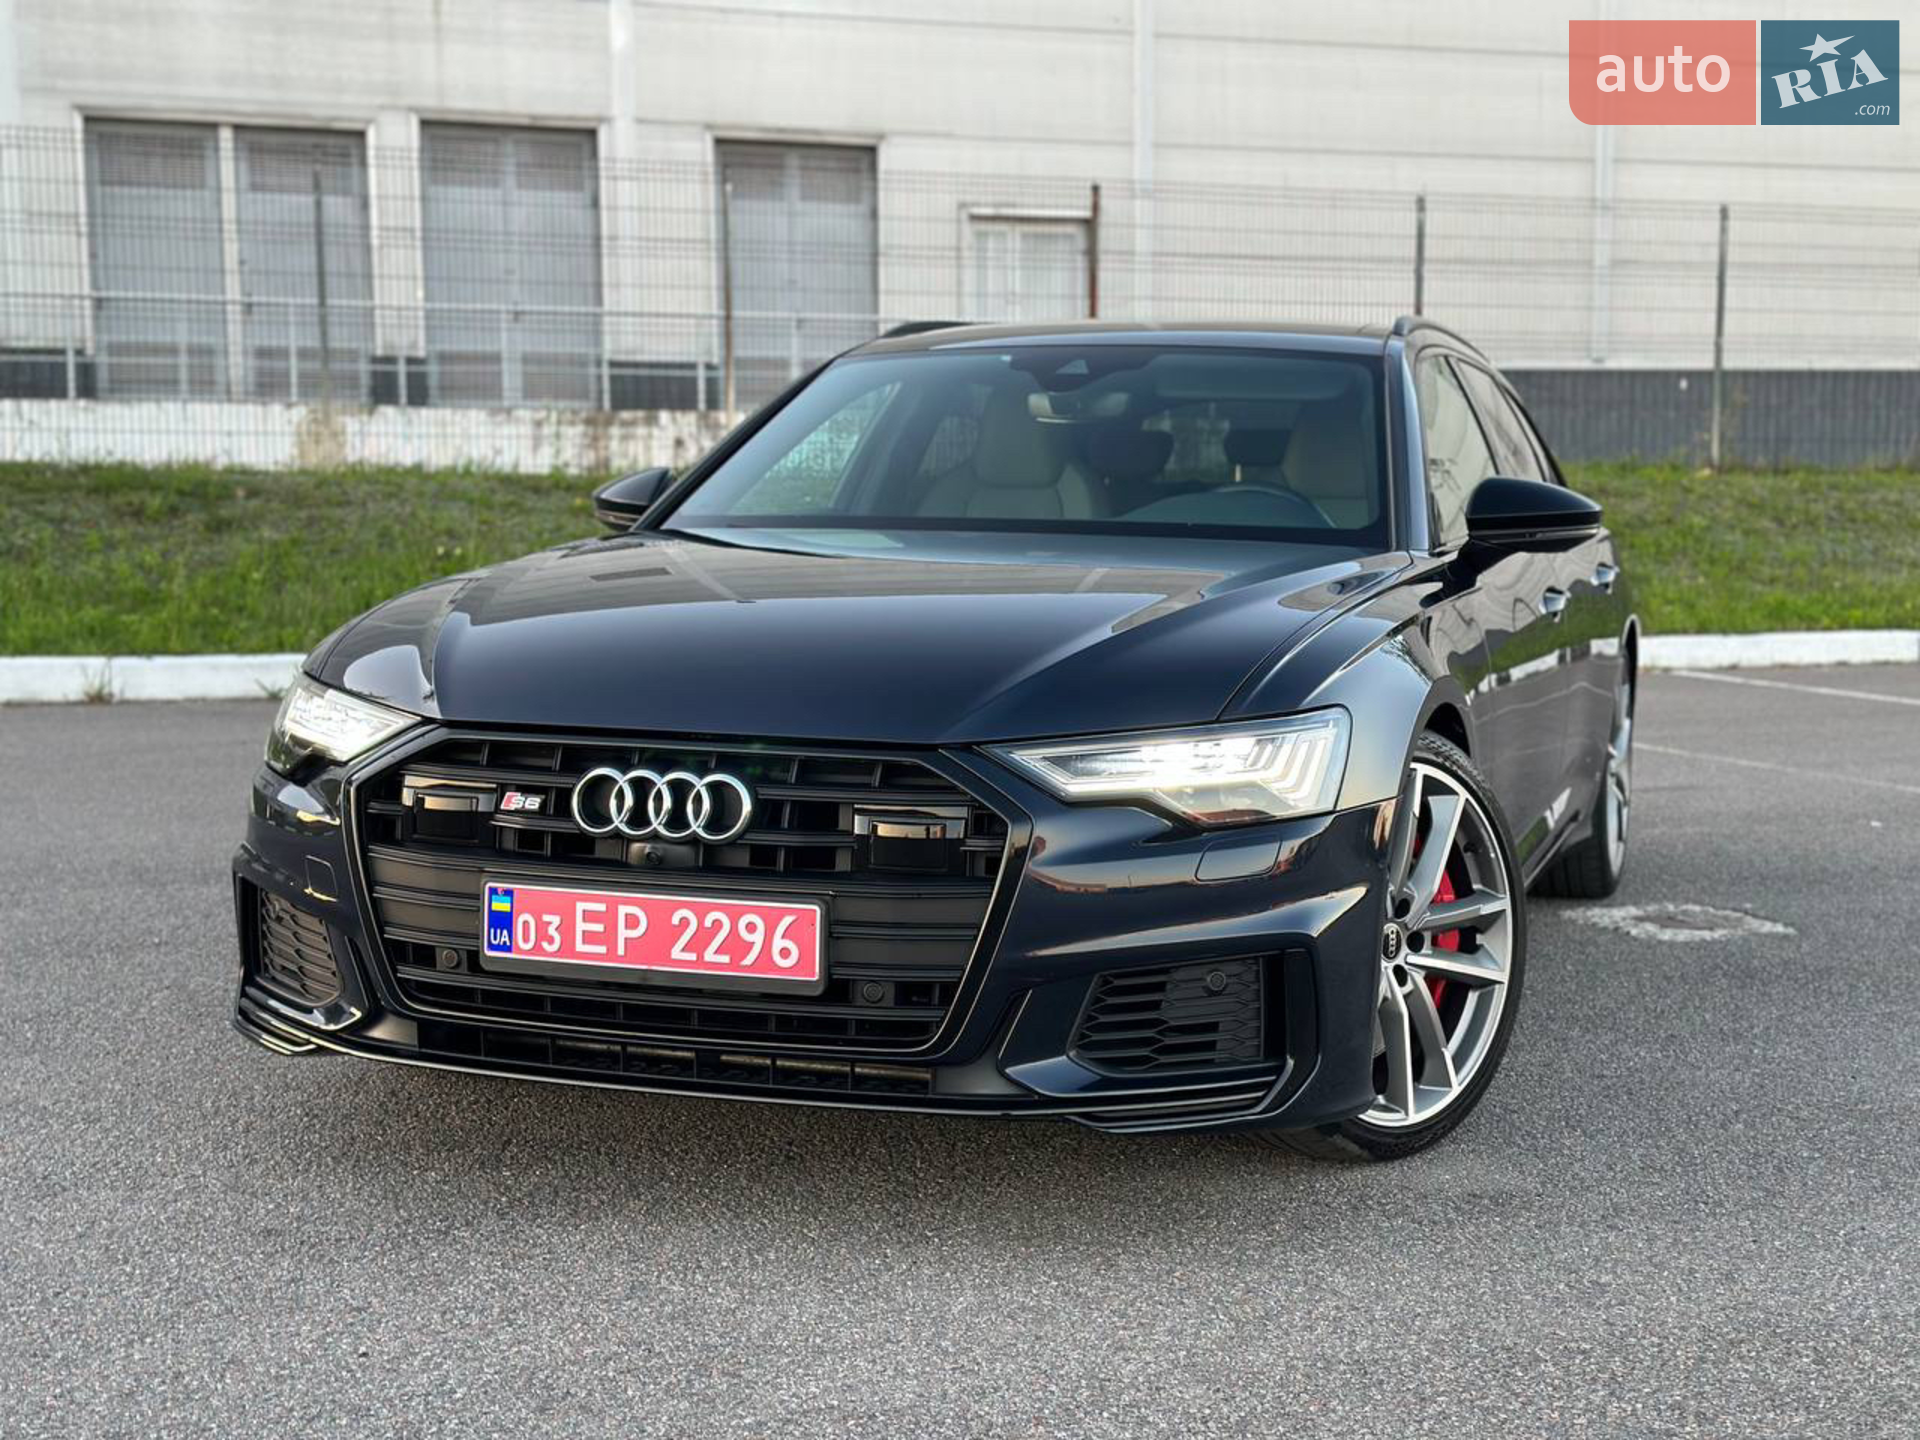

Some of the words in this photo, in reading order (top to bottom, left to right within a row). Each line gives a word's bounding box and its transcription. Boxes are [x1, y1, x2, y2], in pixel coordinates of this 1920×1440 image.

[504, 792, 545, 811] S6
[490, 927, 510, 946] UA
[516, 912, 562, 952] 03
[575, 901, 649, 956] EP
[670, 908, 801, 969] 2296
